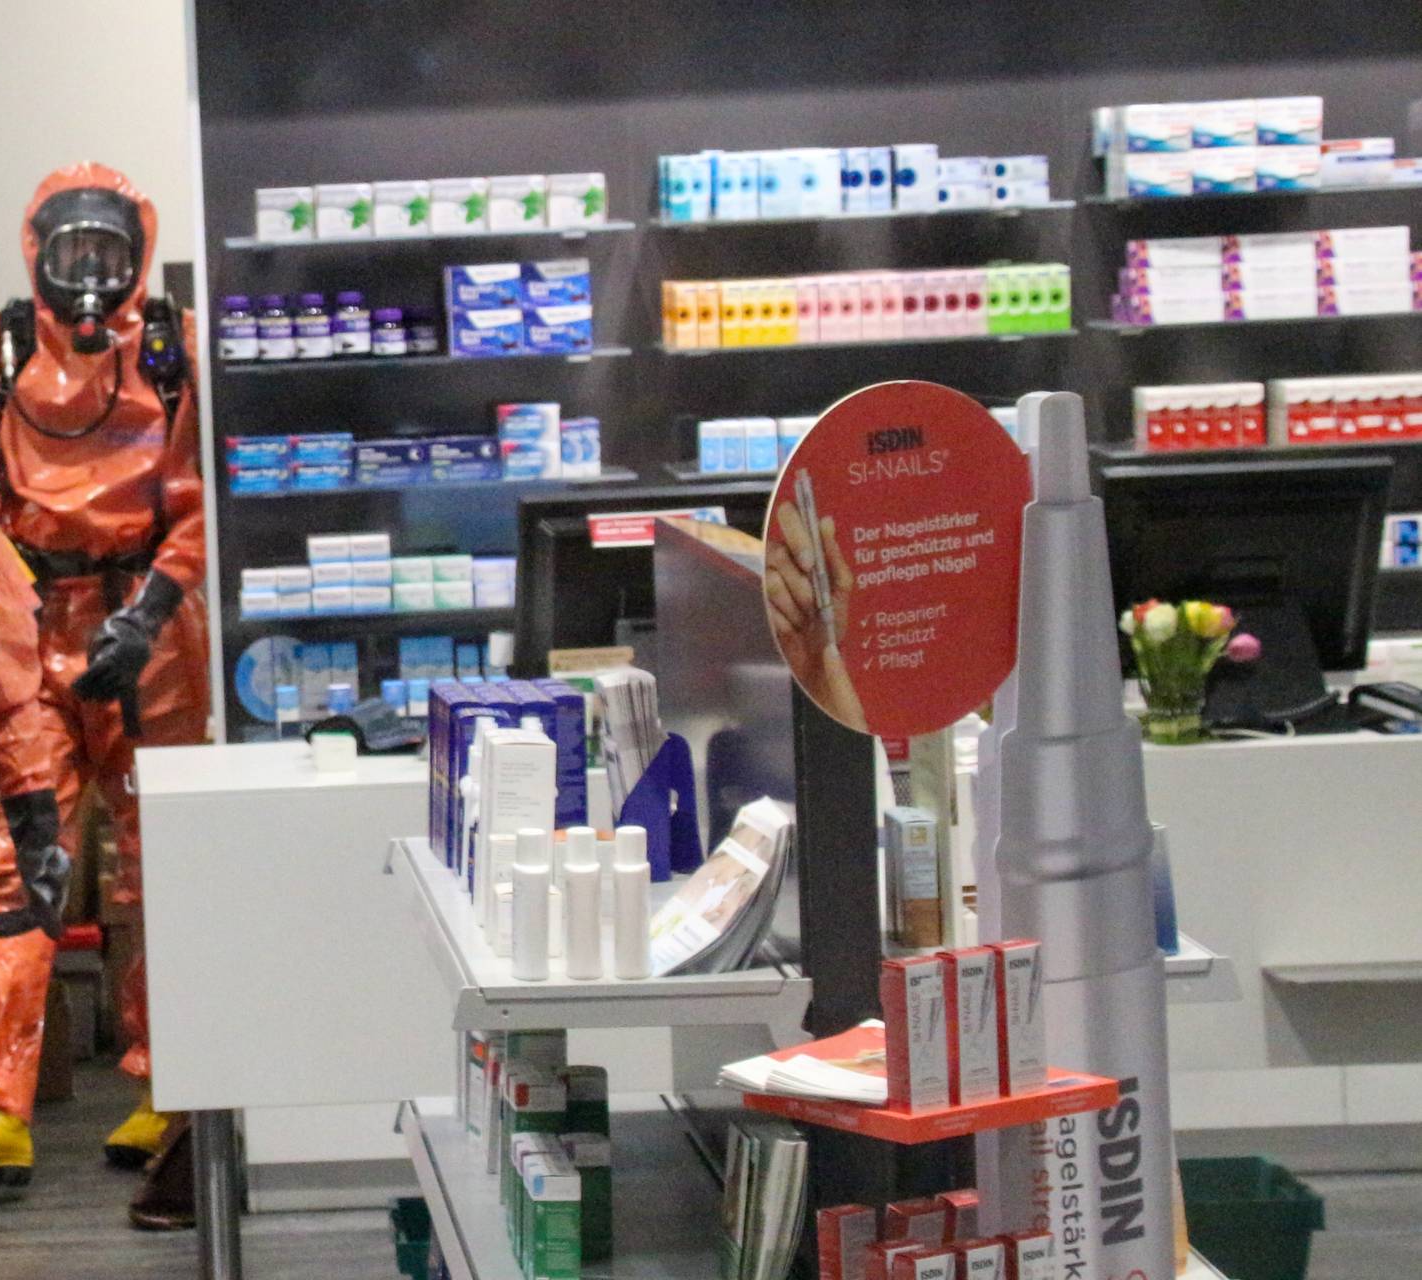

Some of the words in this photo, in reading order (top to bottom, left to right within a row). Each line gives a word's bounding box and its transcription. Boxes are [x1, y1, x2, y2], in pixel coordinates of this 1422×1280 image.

[868, 426, 924, 455] ISDIN
[854, 527, 881, 543] Der
[884, 512, 979, 538] Nagelstärker
[855, 548, 876, 564] für
[881, 536, 963, 563] geschützte
[965, 529, 995, 547] und
[857, 563, 929, 589] gepflegte
[933, 552, 977, 574] Nägel
[877, 603, 947, 628] Repariert
[878, 627, 936, 650] Schützt
[878, 649, 924, 671] Pflegt
[1097, 1077, 1146, 1246] ISDIN
[1032, 1170, 1054, 1230] stre
[1055, 1117, 1087, 1280] agelstärk
